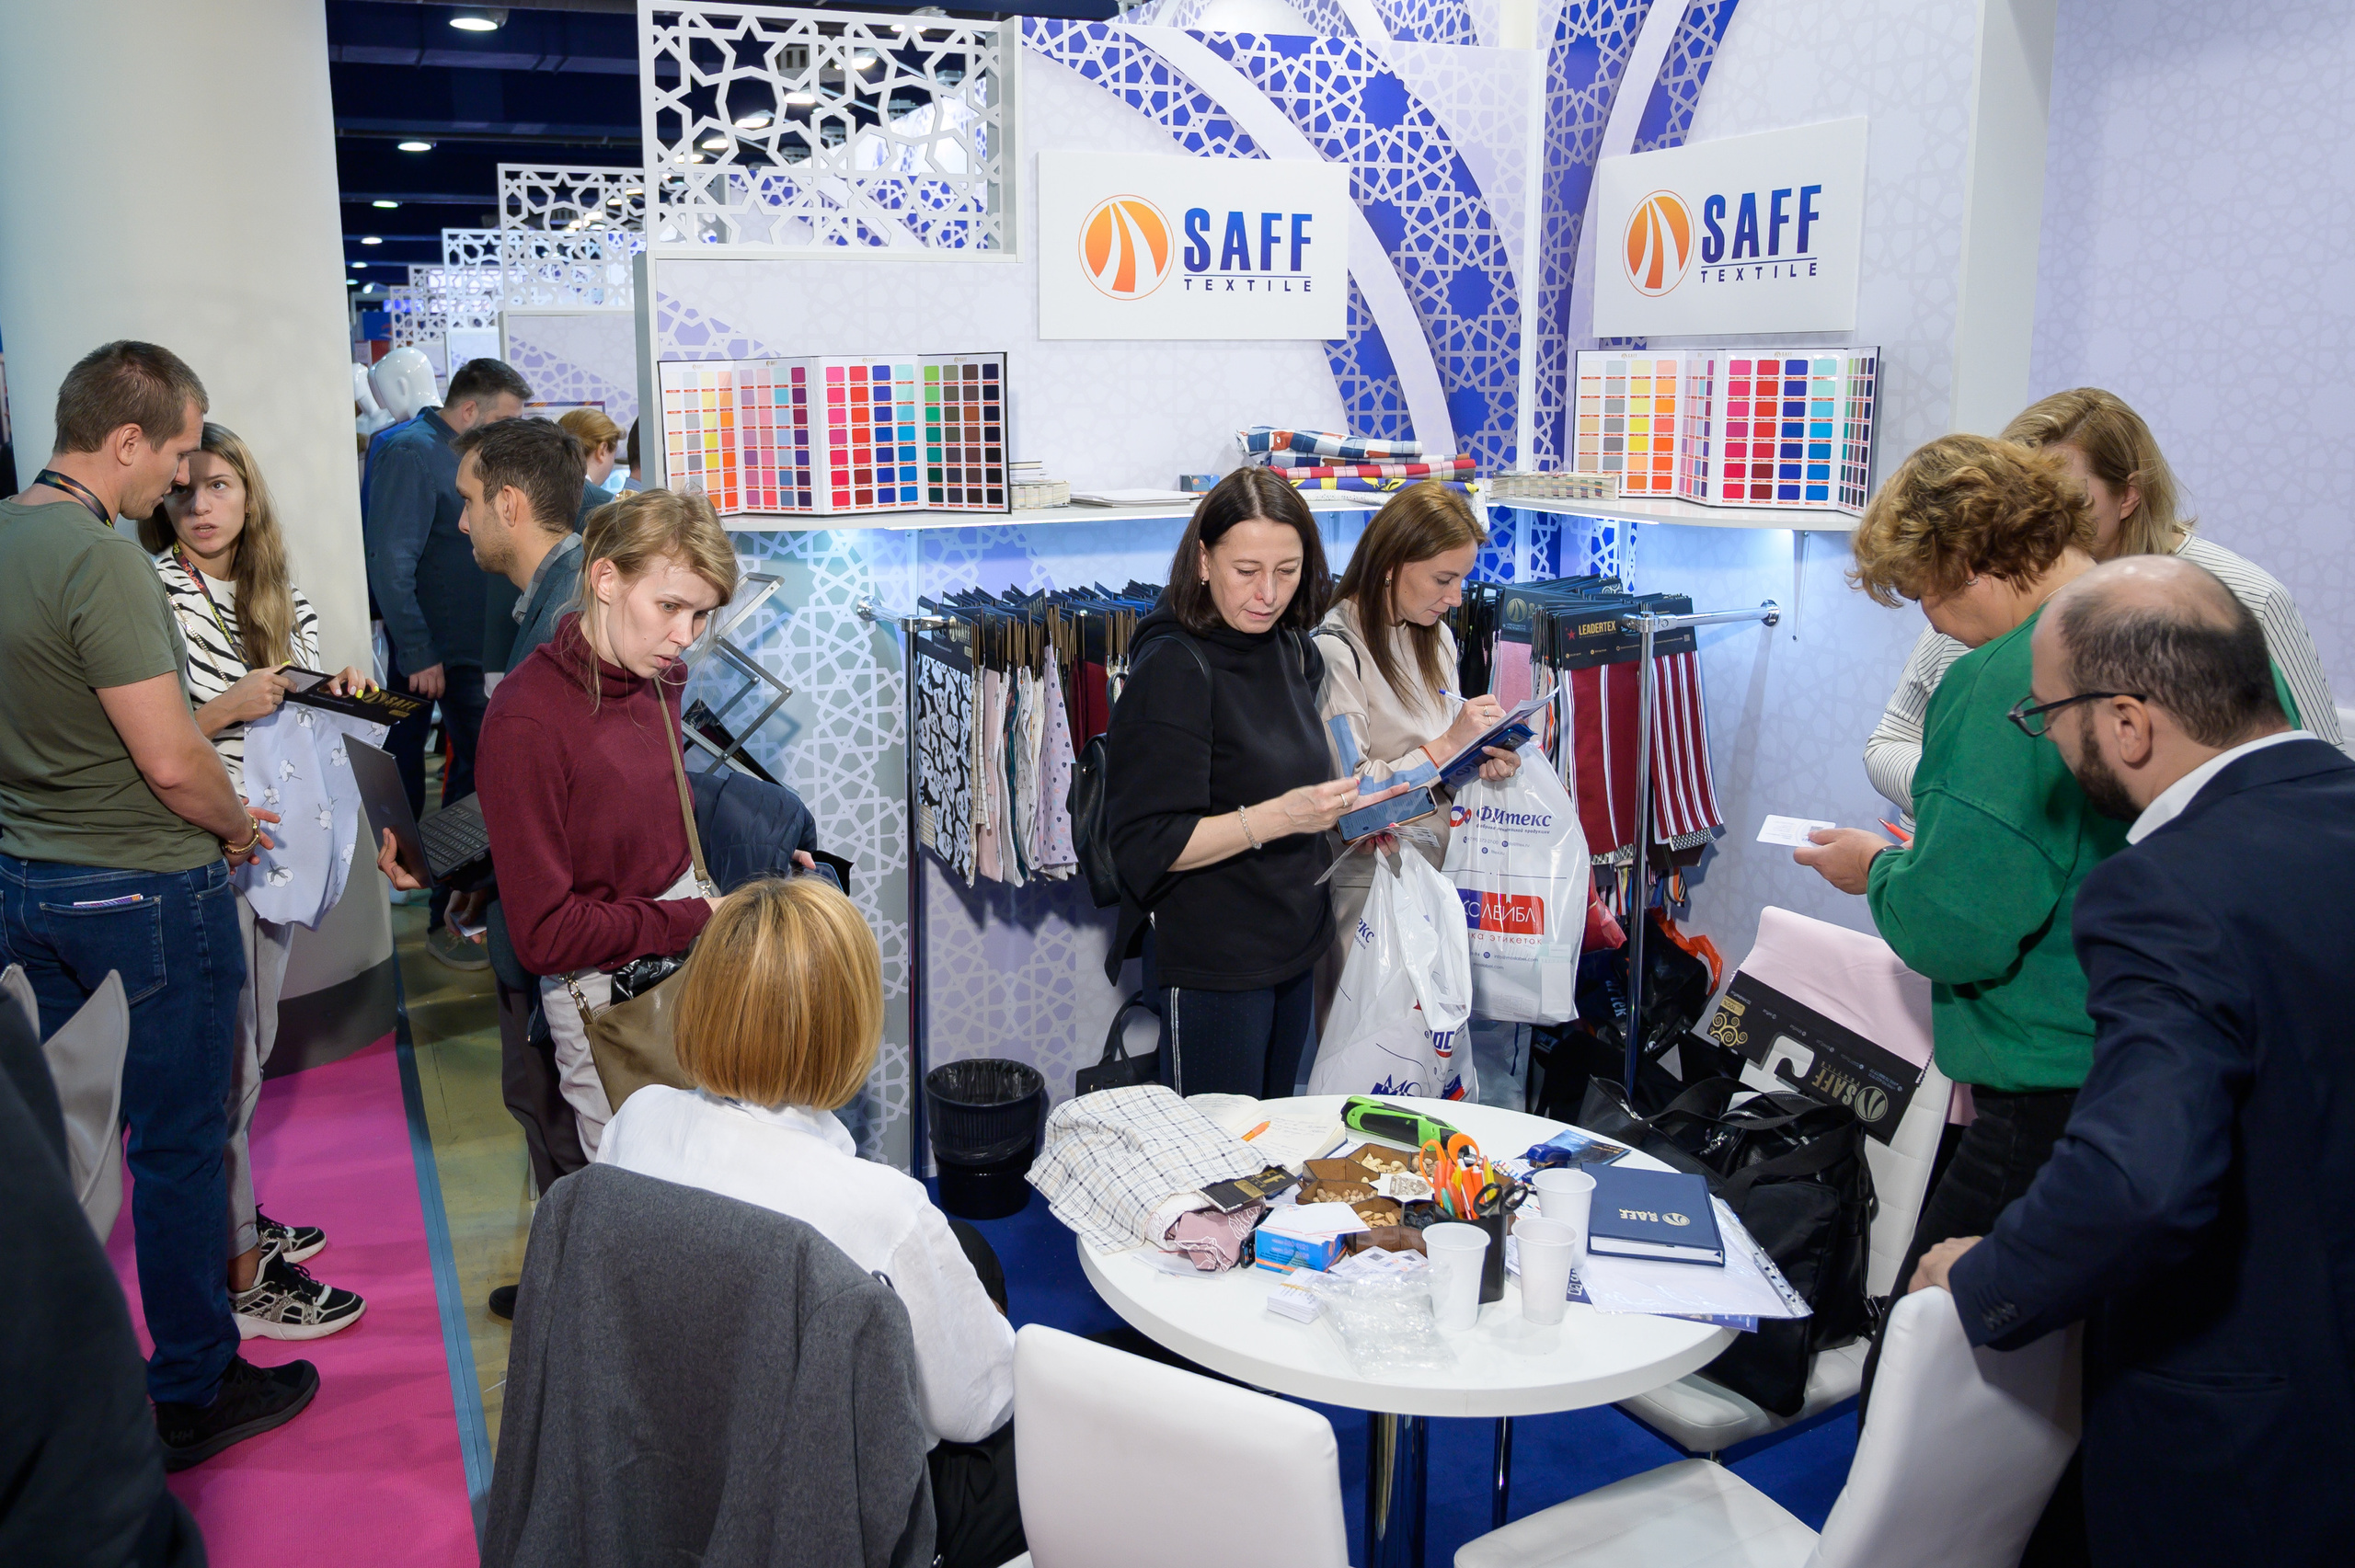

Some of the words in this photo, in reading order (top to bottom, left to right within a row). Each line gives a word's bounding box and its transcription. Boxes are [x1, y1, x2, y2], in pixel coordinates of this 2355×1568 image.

[1702, 184, 1821, 264] SAFF
[1183, 207, 1313, 273] SAFF
[1701, 262, 1818, 283] TEXTILE
[1183, 279, 1312, 292] TEXTILE
[1578, 620, 1616, 635] LEADERTEX
[1489, 934, 1543, 945] этикеток
[1811, 1069, 1858, 1105] SAFF
[1618, 1209, 1659, 1222] SAFF
